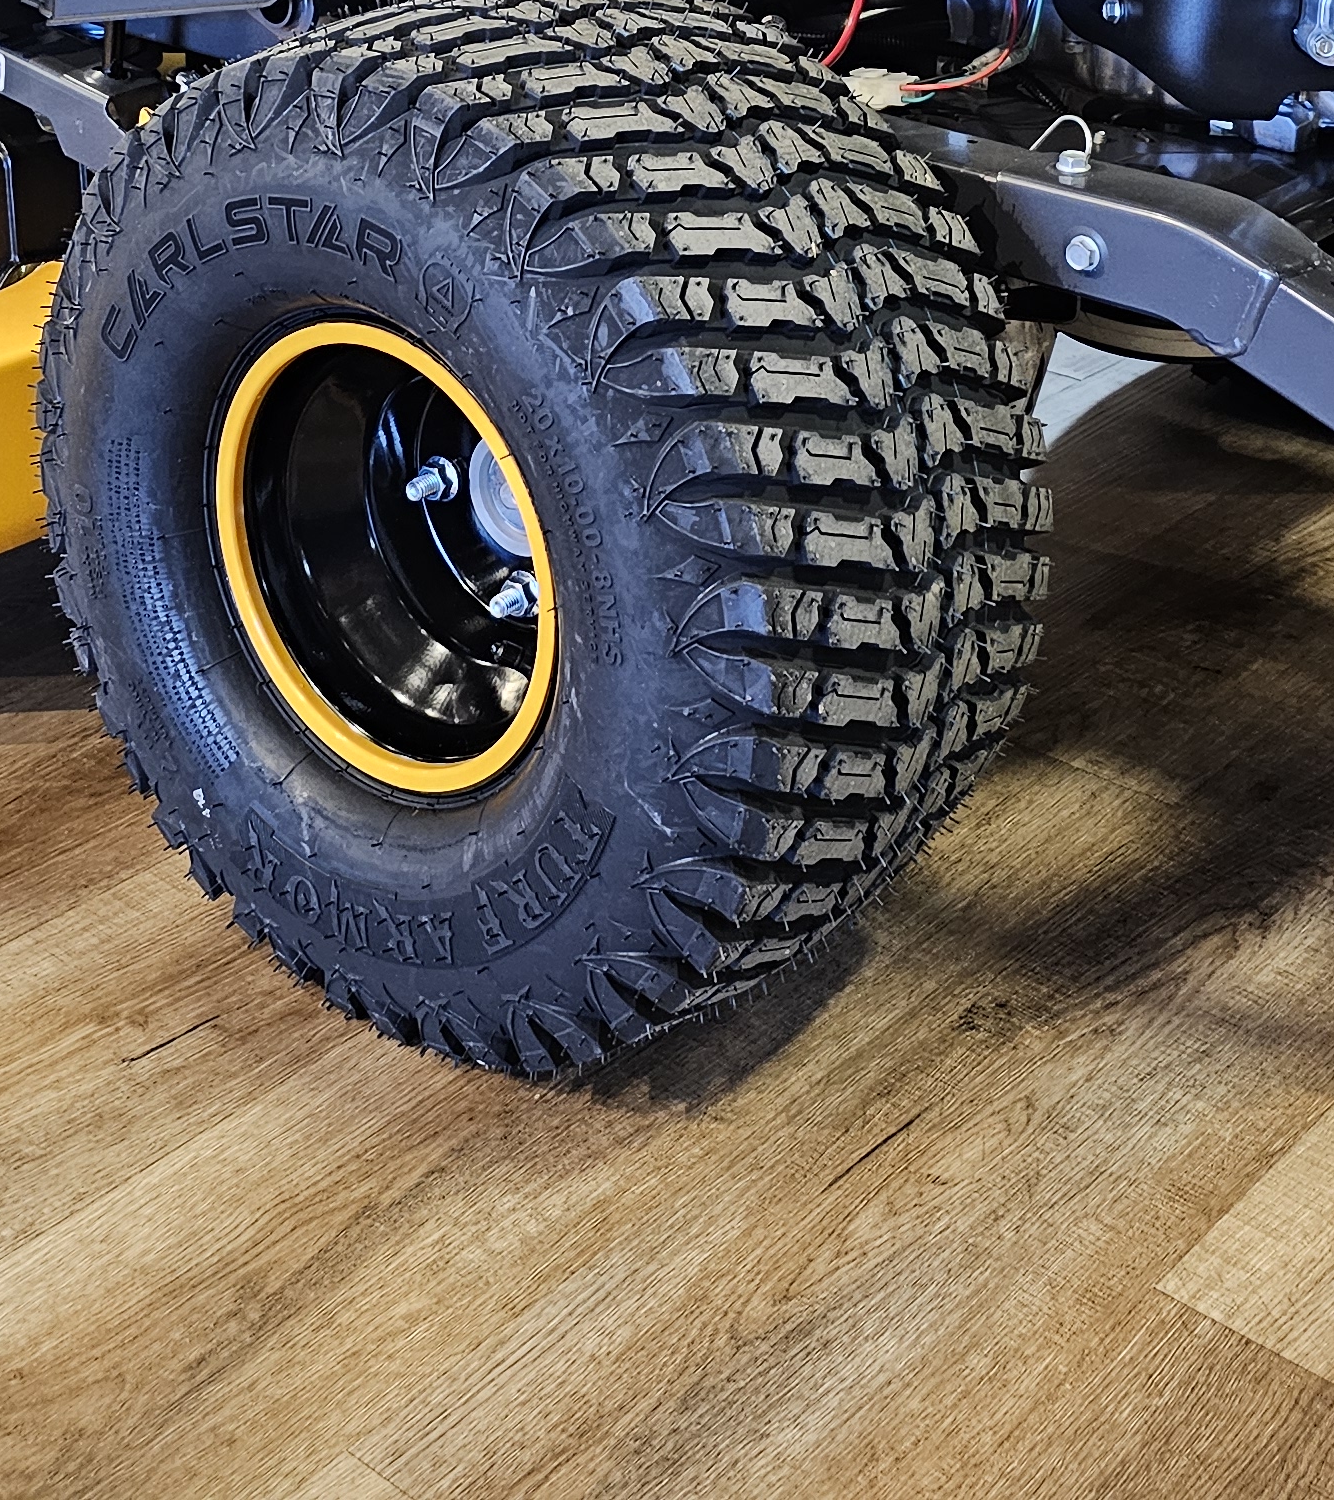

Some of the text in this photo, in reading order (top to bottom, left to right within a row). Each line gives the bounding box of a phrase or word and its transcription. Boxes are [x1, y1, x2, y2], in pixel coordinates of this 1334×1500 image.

[100, 193, 405, 364] CARLSTAR
[246, 809, 609, 965] TURF ARMOR
